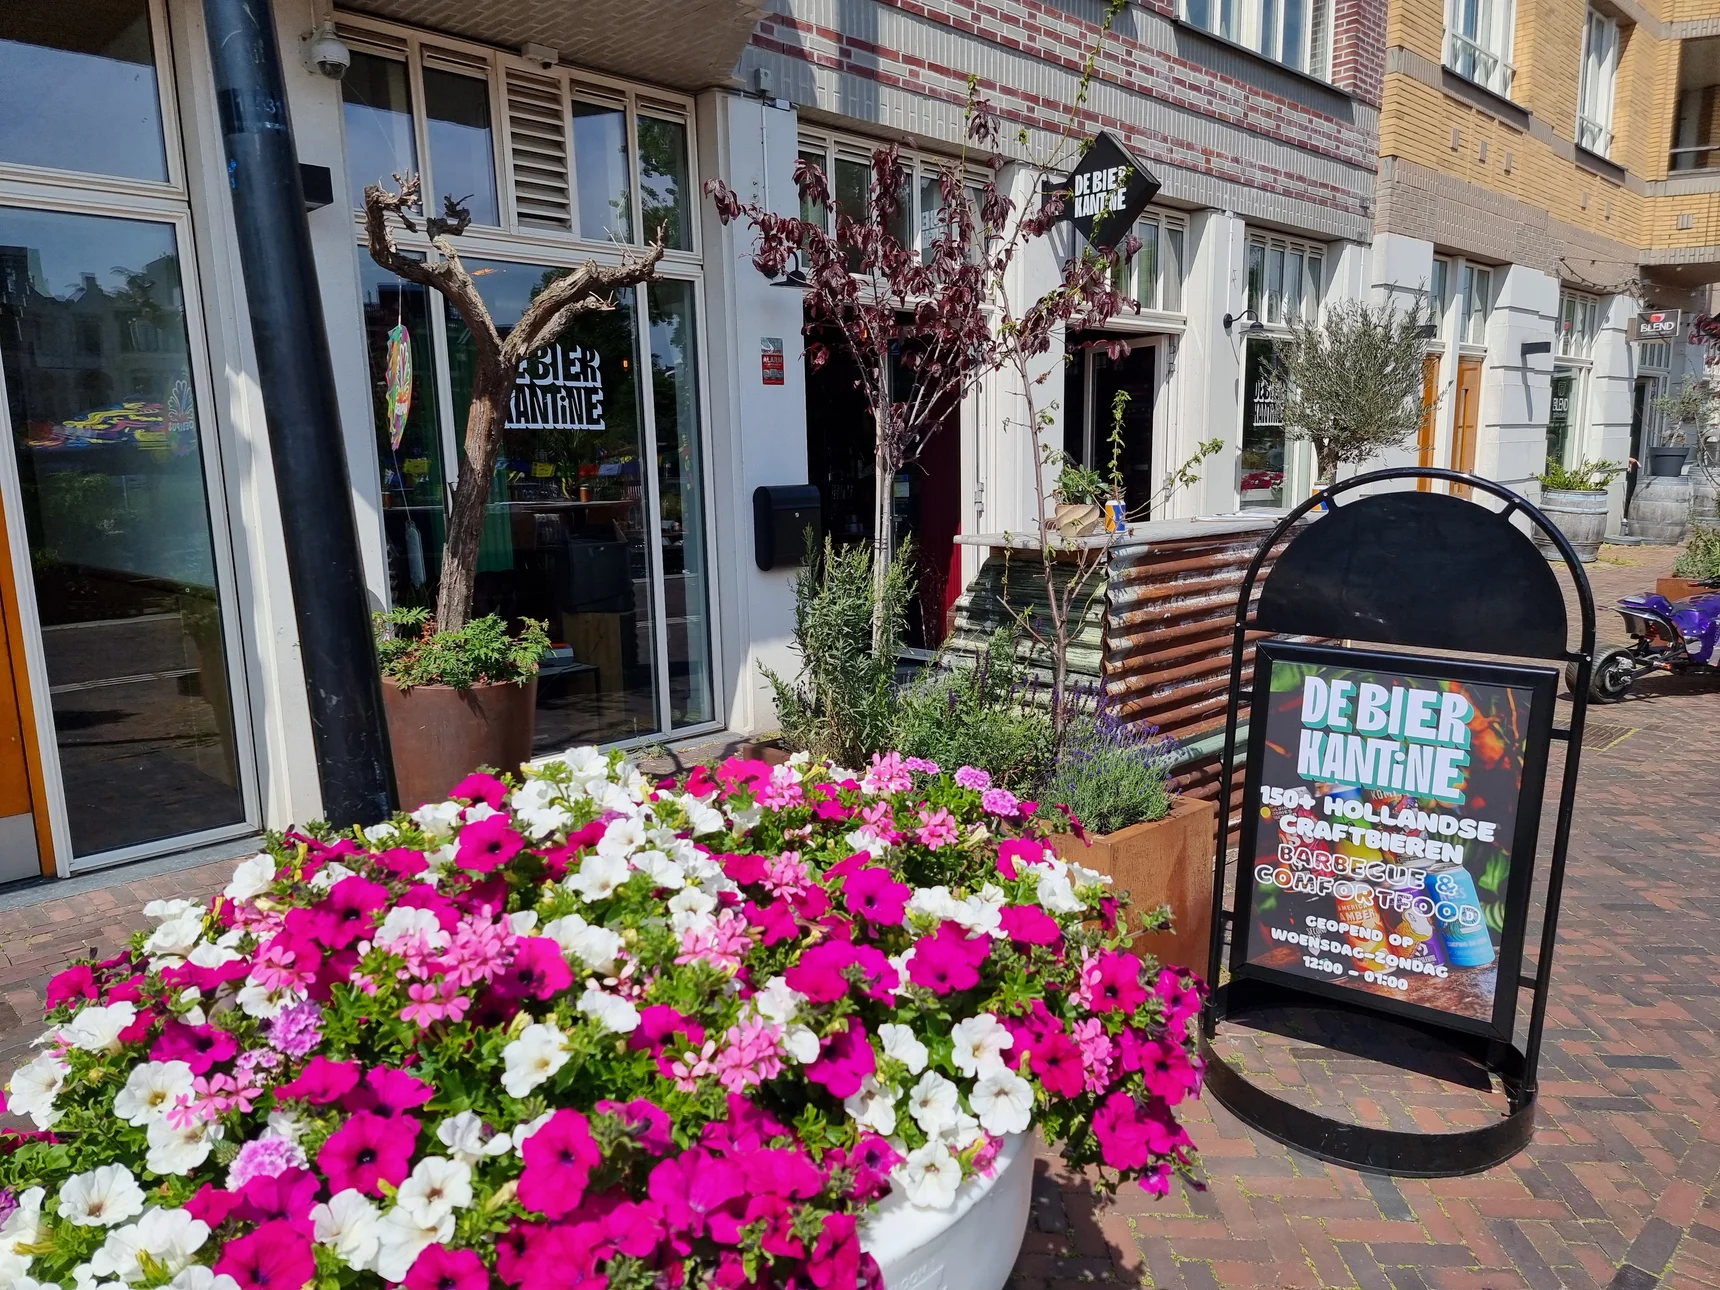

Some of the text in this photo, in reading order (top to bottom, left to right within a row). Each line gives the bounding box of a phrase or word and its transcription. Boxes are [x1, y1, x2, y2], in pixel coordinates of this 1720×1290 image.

[1074, 165, 1126, 196] DE BIER
[1074, 188, 1127, 218] KANTNE
[1640, 321, 1675, 333] BLEND
[532, 343, 602, 388] BIER
[1552, 397, 1569, 411] BLEND
[1301, 676, 1474, 751] DE BIER
[1297, 728, 1471, 805] KANTiNE
[1260, 785, 1497, 843] 150+ HOLLANDSE
[1279, 814, 1464, 865] CRAFTBIEREN
[1277, 843, 1427, 890] BARBECUE
[1435, 874, 1458, 896] &
[1254, 864, 1481, 926] COMFORTFOOD
[1337, 902, 1369, 911] AMERICA
[1339, 908, 1376, 922] AMBER
[1305, 915, 1384, 943] GEOPEND
[1388, 933, 1415, 948] OP
[1271, 927, 1449, 979] WOENSDAG-ZONDAG
[1302, 955, 1343, 975] 12:00
[1363, 970, 1409, 991] 01:00
